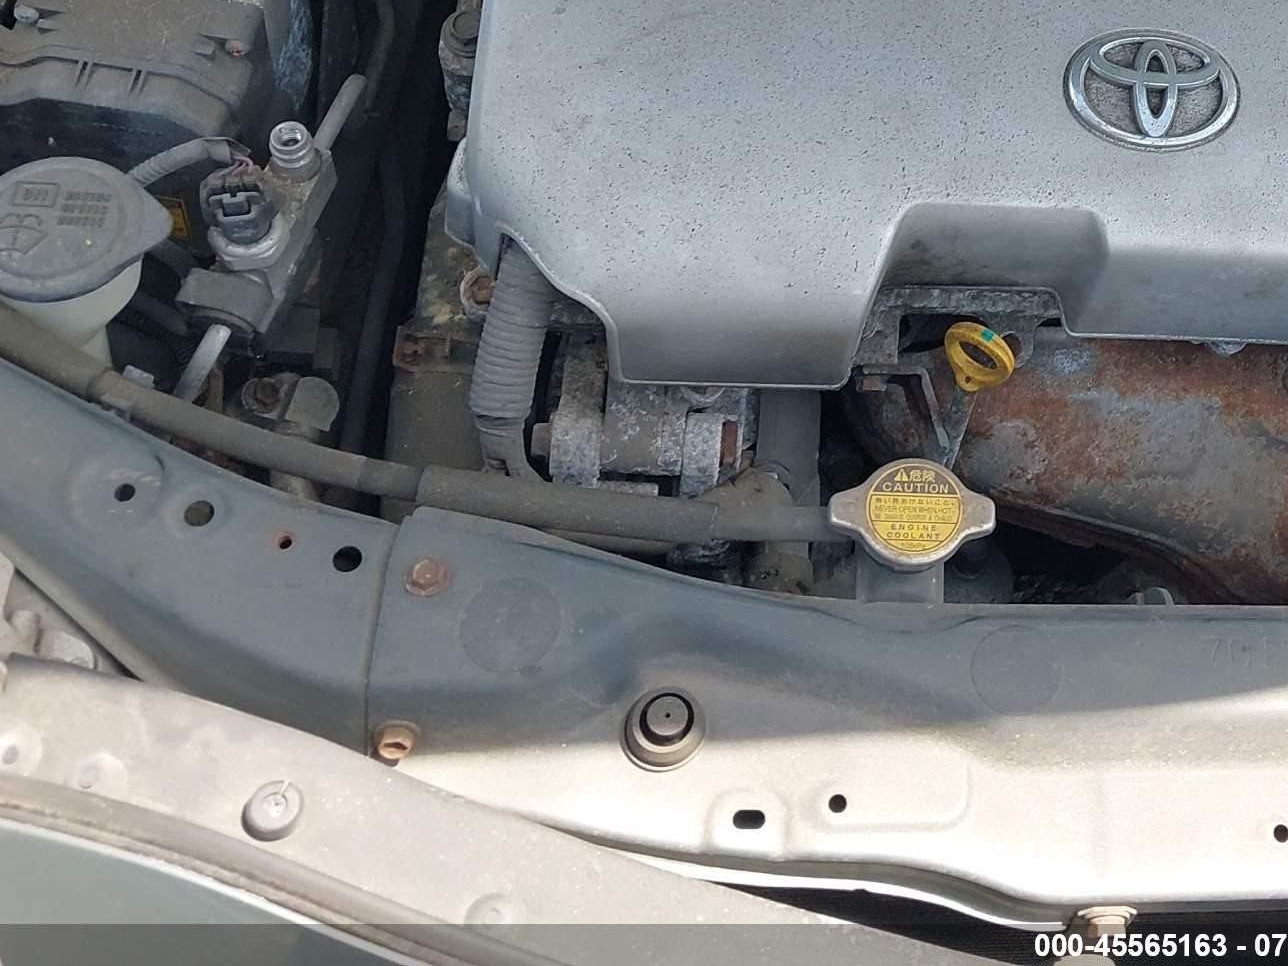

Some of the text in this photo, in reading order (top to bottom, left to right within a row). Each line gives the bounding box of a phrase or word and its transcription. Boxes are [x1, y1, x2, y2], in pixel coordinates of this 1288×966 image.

[882, 482, 949, 494] CAUTION
[891, 523, 937, 532] ENGINE
[886, 531, 941, 540] COOLANT
